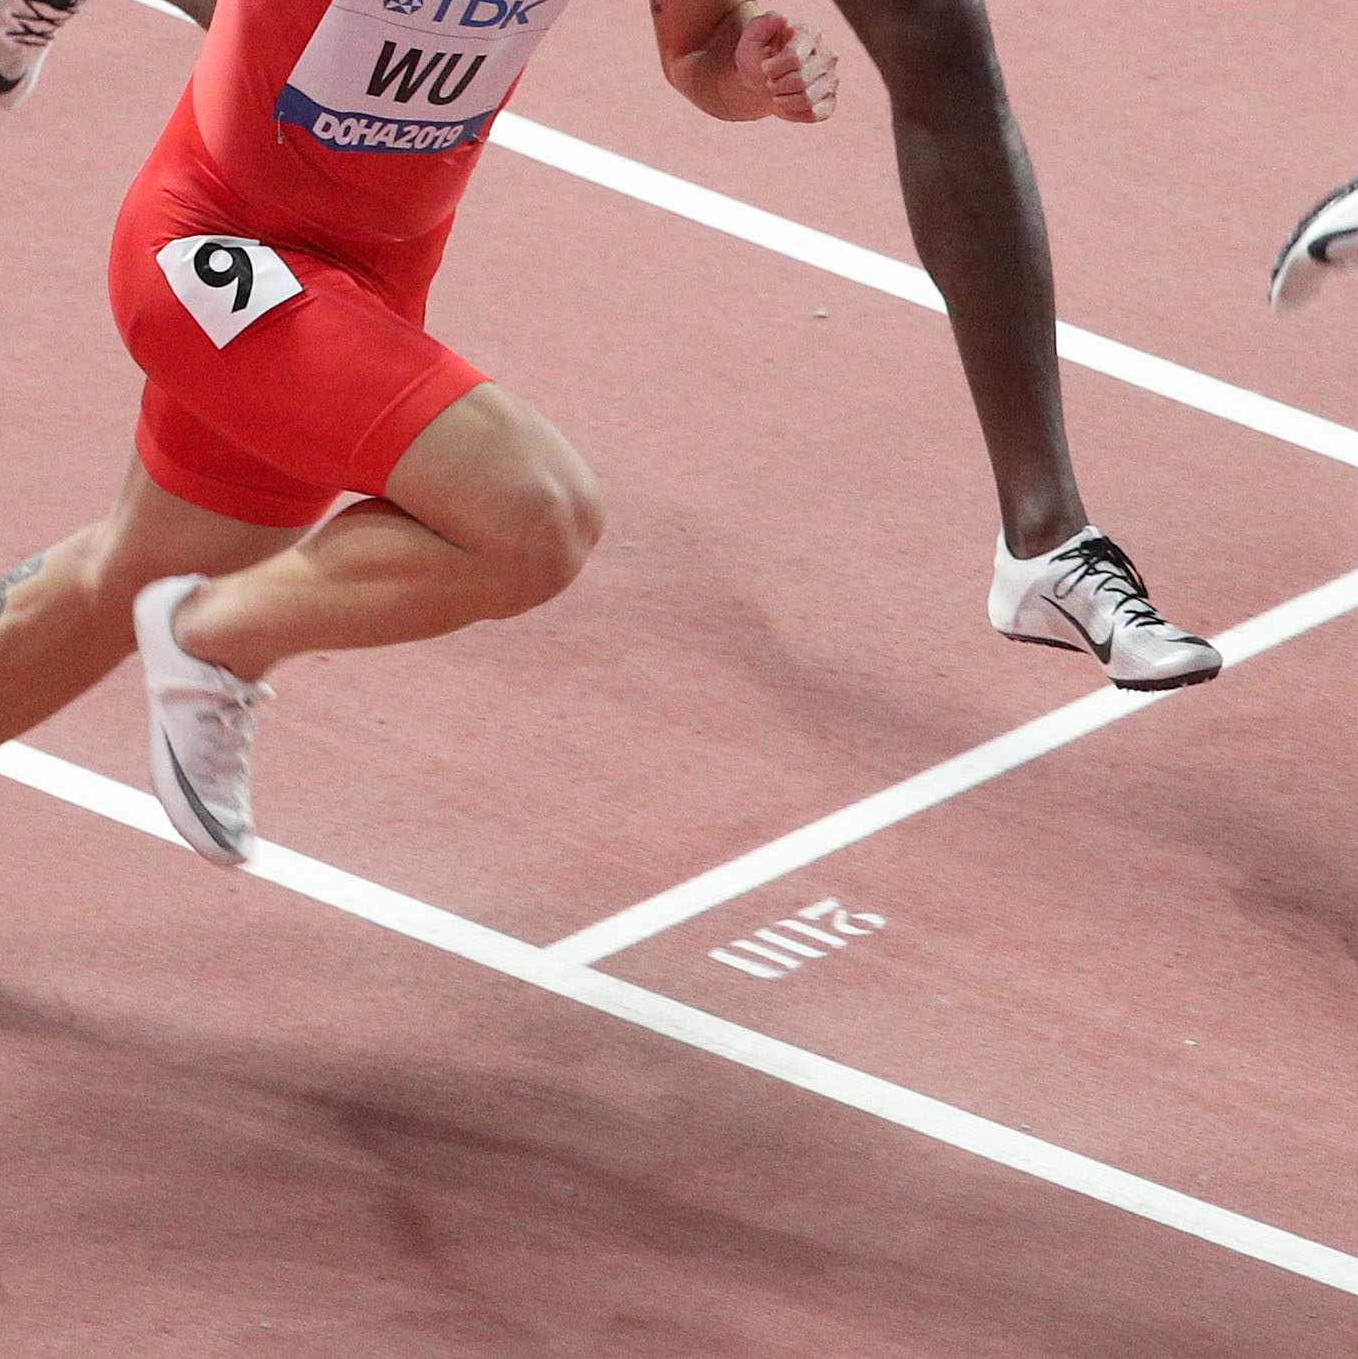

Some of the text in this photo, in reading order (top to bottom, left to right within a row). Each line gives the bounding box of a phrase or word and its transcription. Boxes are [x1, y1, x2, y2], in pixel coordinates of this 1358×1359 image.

[366, 40, 487, 106] WU
[312, 111, 464, 150] DOHA2019
[193, 242, 254, 313] 9
